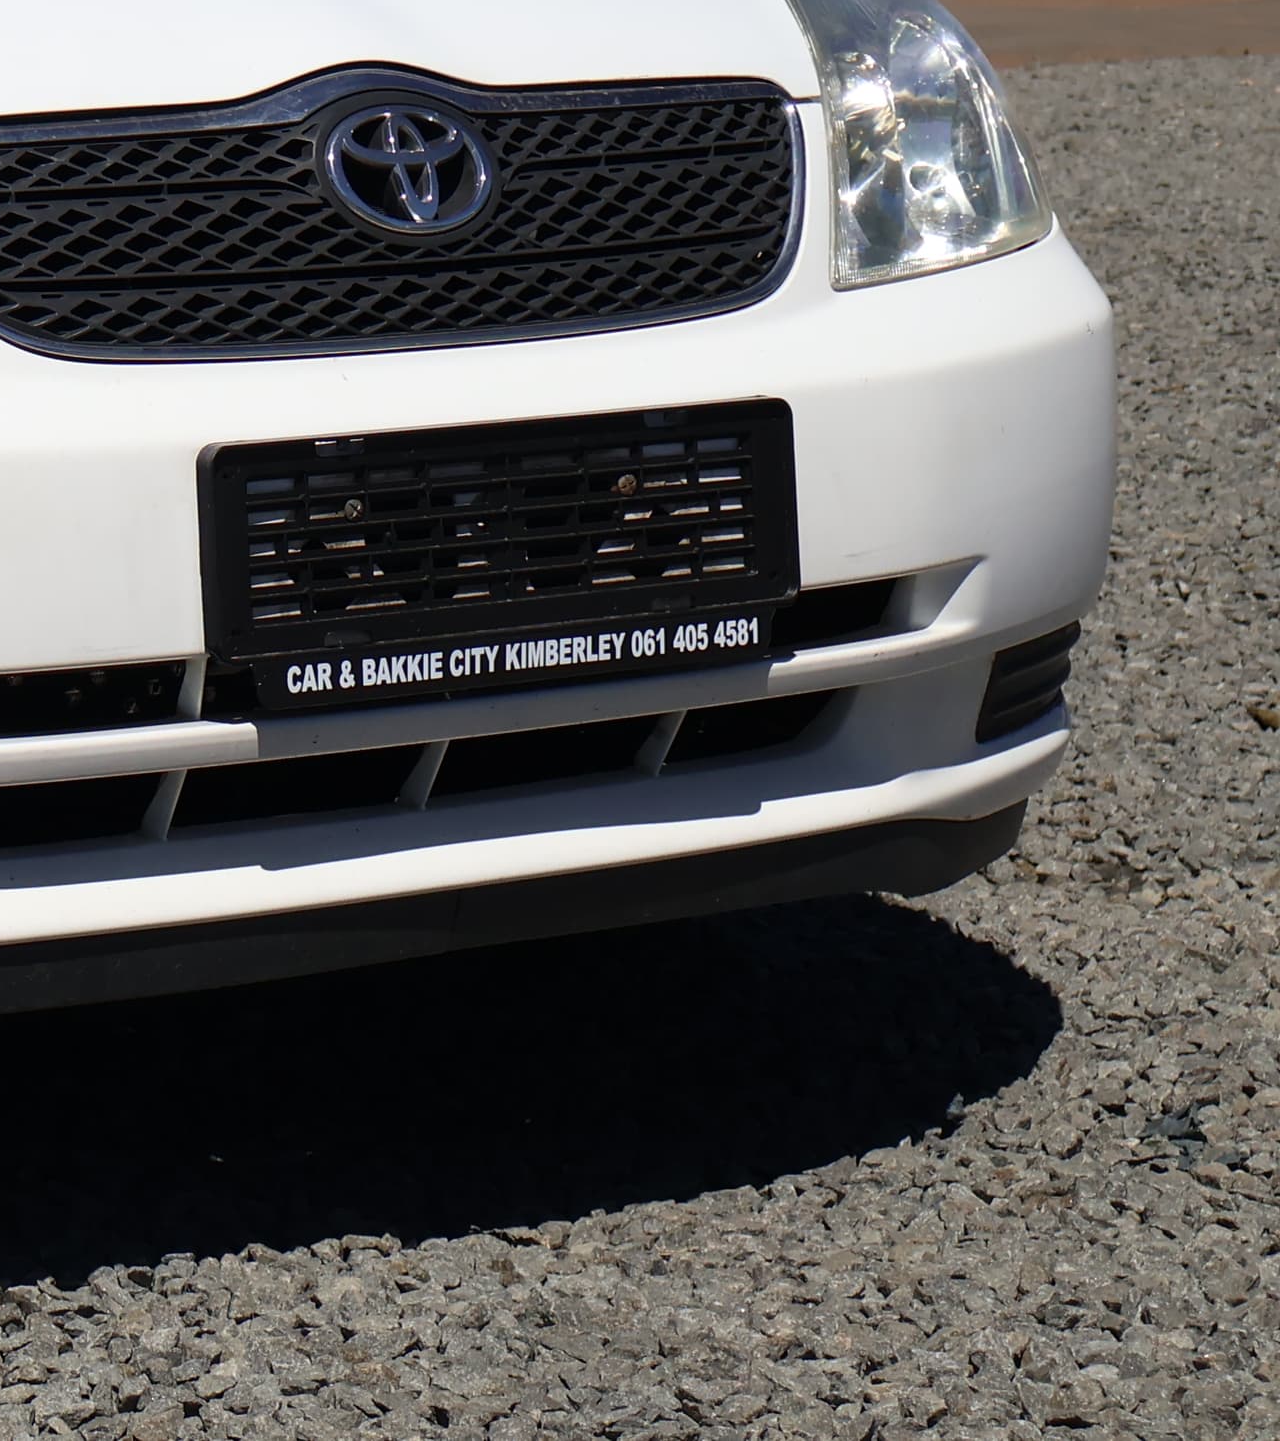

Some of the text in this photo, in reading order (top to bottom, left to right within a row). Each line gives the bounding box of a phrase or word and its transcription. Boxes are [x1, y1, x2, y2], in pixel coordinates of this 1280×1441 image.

[286, 617, 760, 694] CAR & BAKKIE CITY KIMBERLEY 061 405 4581
